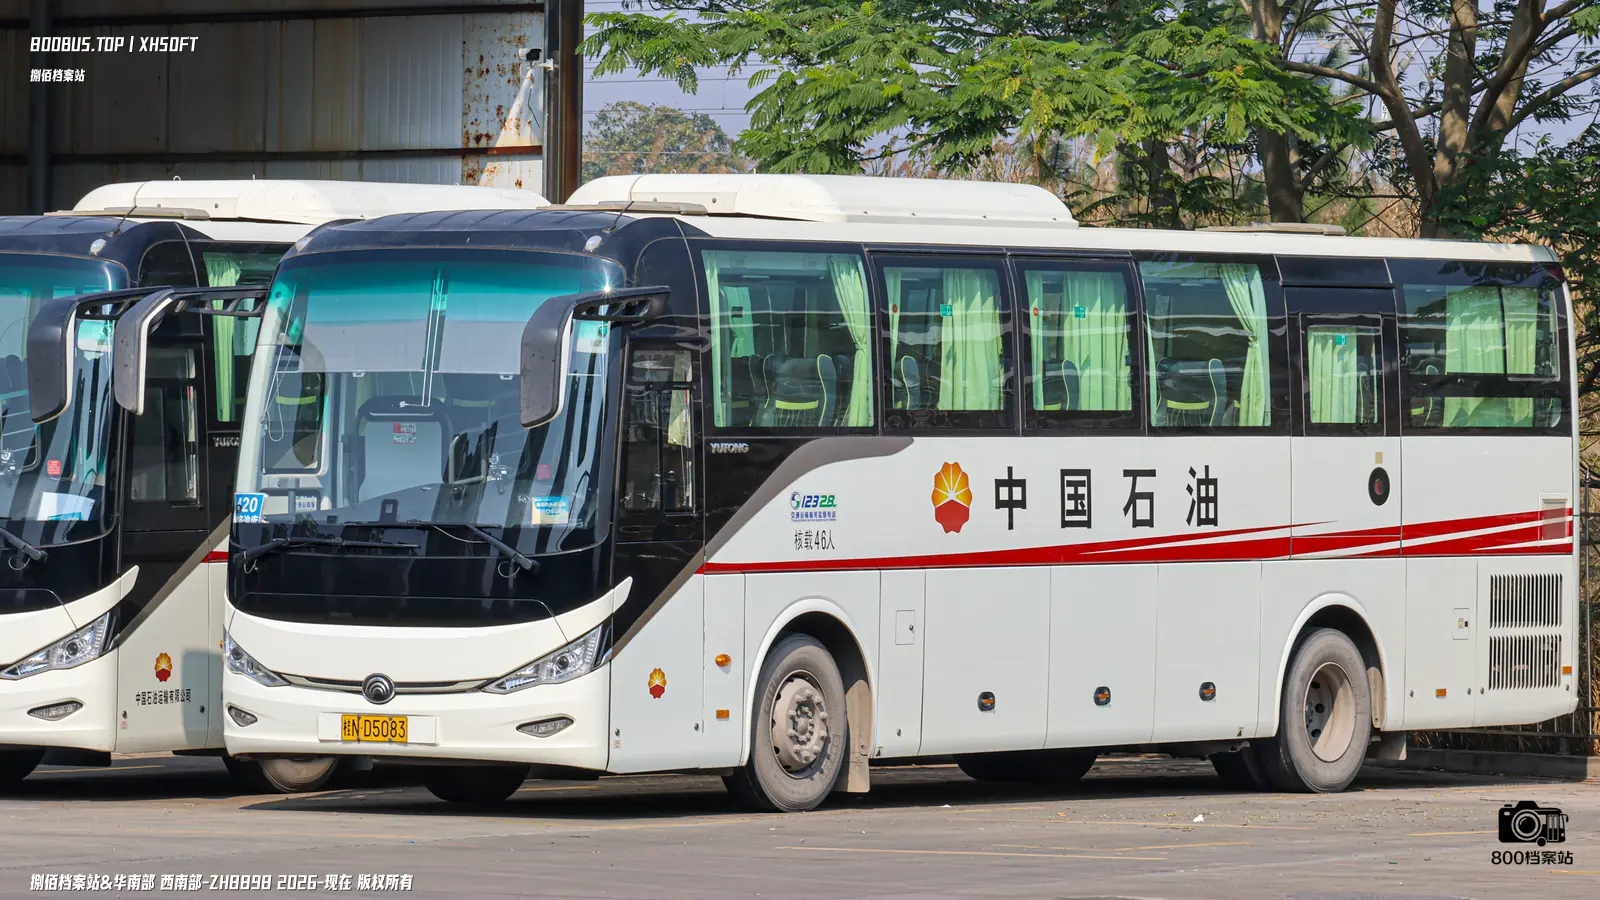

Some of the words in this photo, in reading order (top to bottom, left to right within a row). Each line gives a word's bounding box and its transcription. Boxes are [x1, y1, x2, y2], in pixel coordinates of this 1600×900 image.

[709, 442, 750, 454] YUTONG
[801, 494, 838, 508] 12328
[994, 464, 1219, 531] 中国石油
[793, 529, 836, 550] 核载46人
[135, 688, 192, 707] 中国石油运输有限公司
